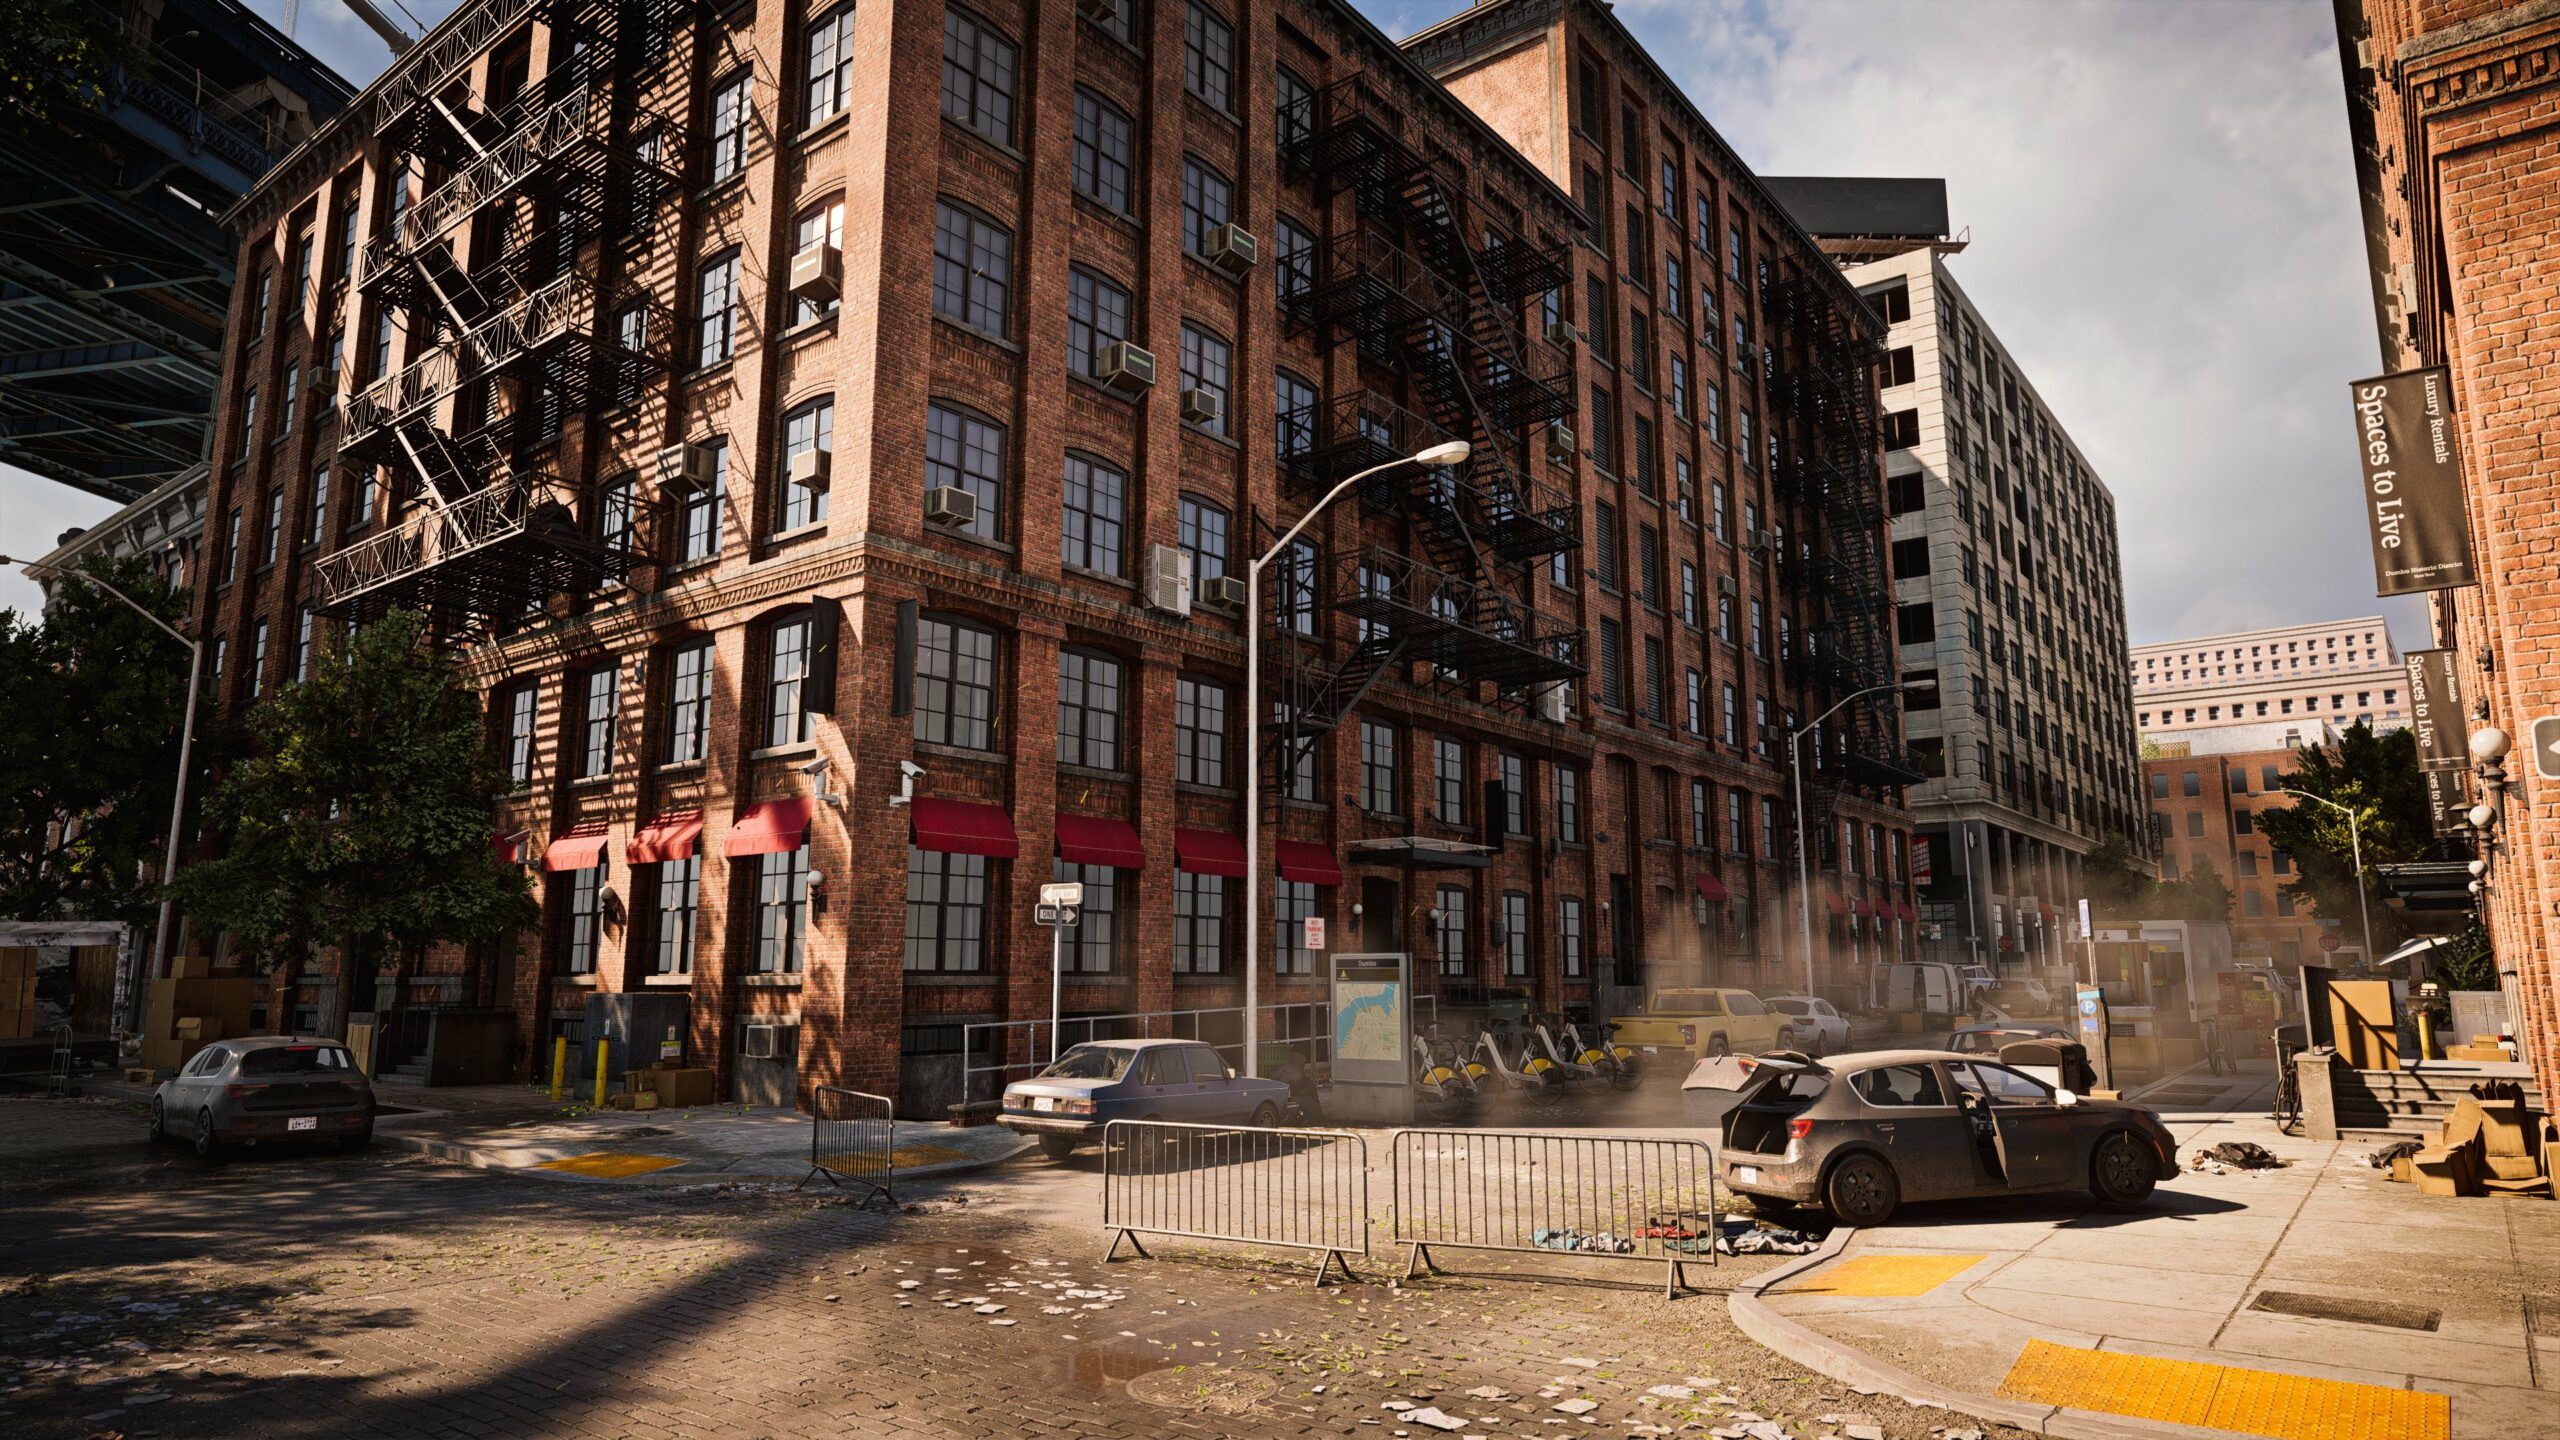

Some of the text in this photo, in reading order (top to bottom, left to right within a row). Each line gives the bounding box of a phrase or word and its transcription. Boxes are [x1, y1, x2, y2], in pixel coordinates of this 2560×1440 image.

[2425, 374, 2450, 464] Luxury Rentals
[2357, 385, 2405, 549] Spaces to Live
[2385, 561, 2463, 577] Dumbo Historic District
[2444, 652, 2458, 703] Luxury Rentals
[2407, 655, 2434, 748] Spaces to Live
[2429, 771, 2439, 789] ces
[2432, 790, 2442, 800] to
[2433, 801, 2445, 821] Live
[1043, 910, 1054, 919] ONE
[1358, 960, 1377, 968] Dumbo
